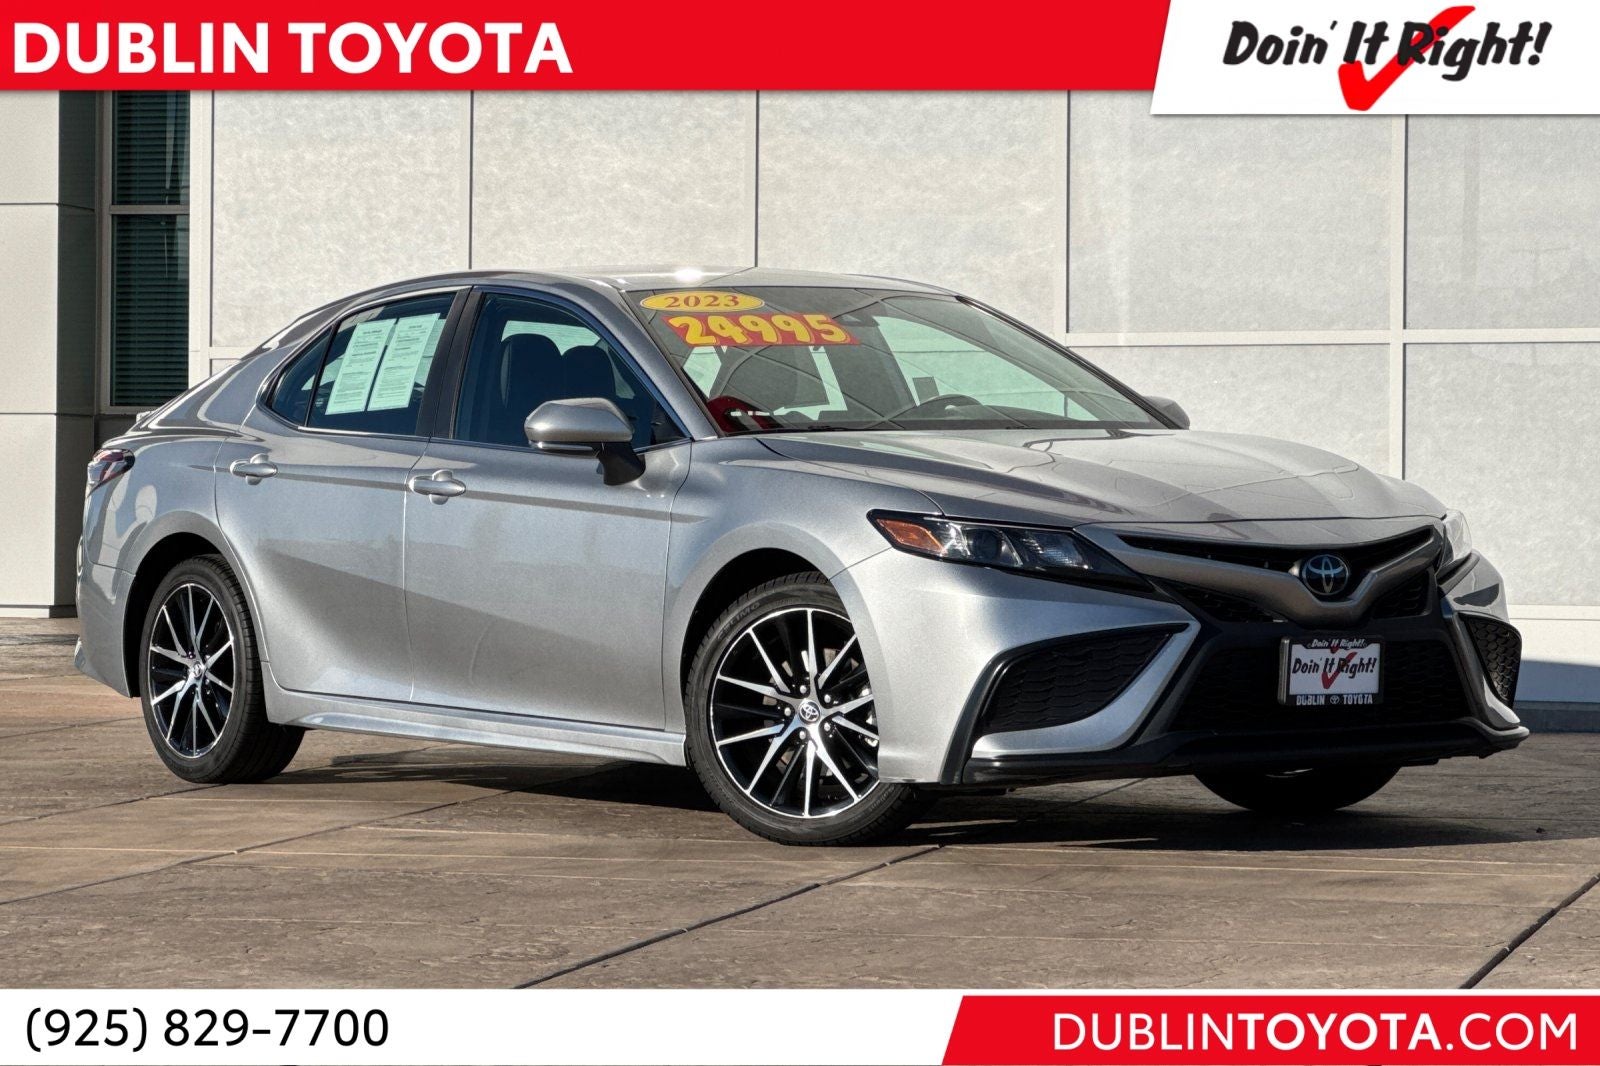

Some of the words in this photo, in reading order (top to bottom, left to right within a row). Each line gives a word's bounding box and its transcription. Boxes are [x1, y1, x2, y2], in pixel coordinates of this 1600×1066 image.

[664, 294, 740, 309] 2023
[668, 314, 850, 345] 24995
[1292, 658, 1322, 674] Doin'
[1323, 658, 1334, 673] It
[1338, 658, 1377, 679] Right!
[1296, 695, 1325, 706] DUBLIN
[1343, 694, 1373, 705] TOYOTA
